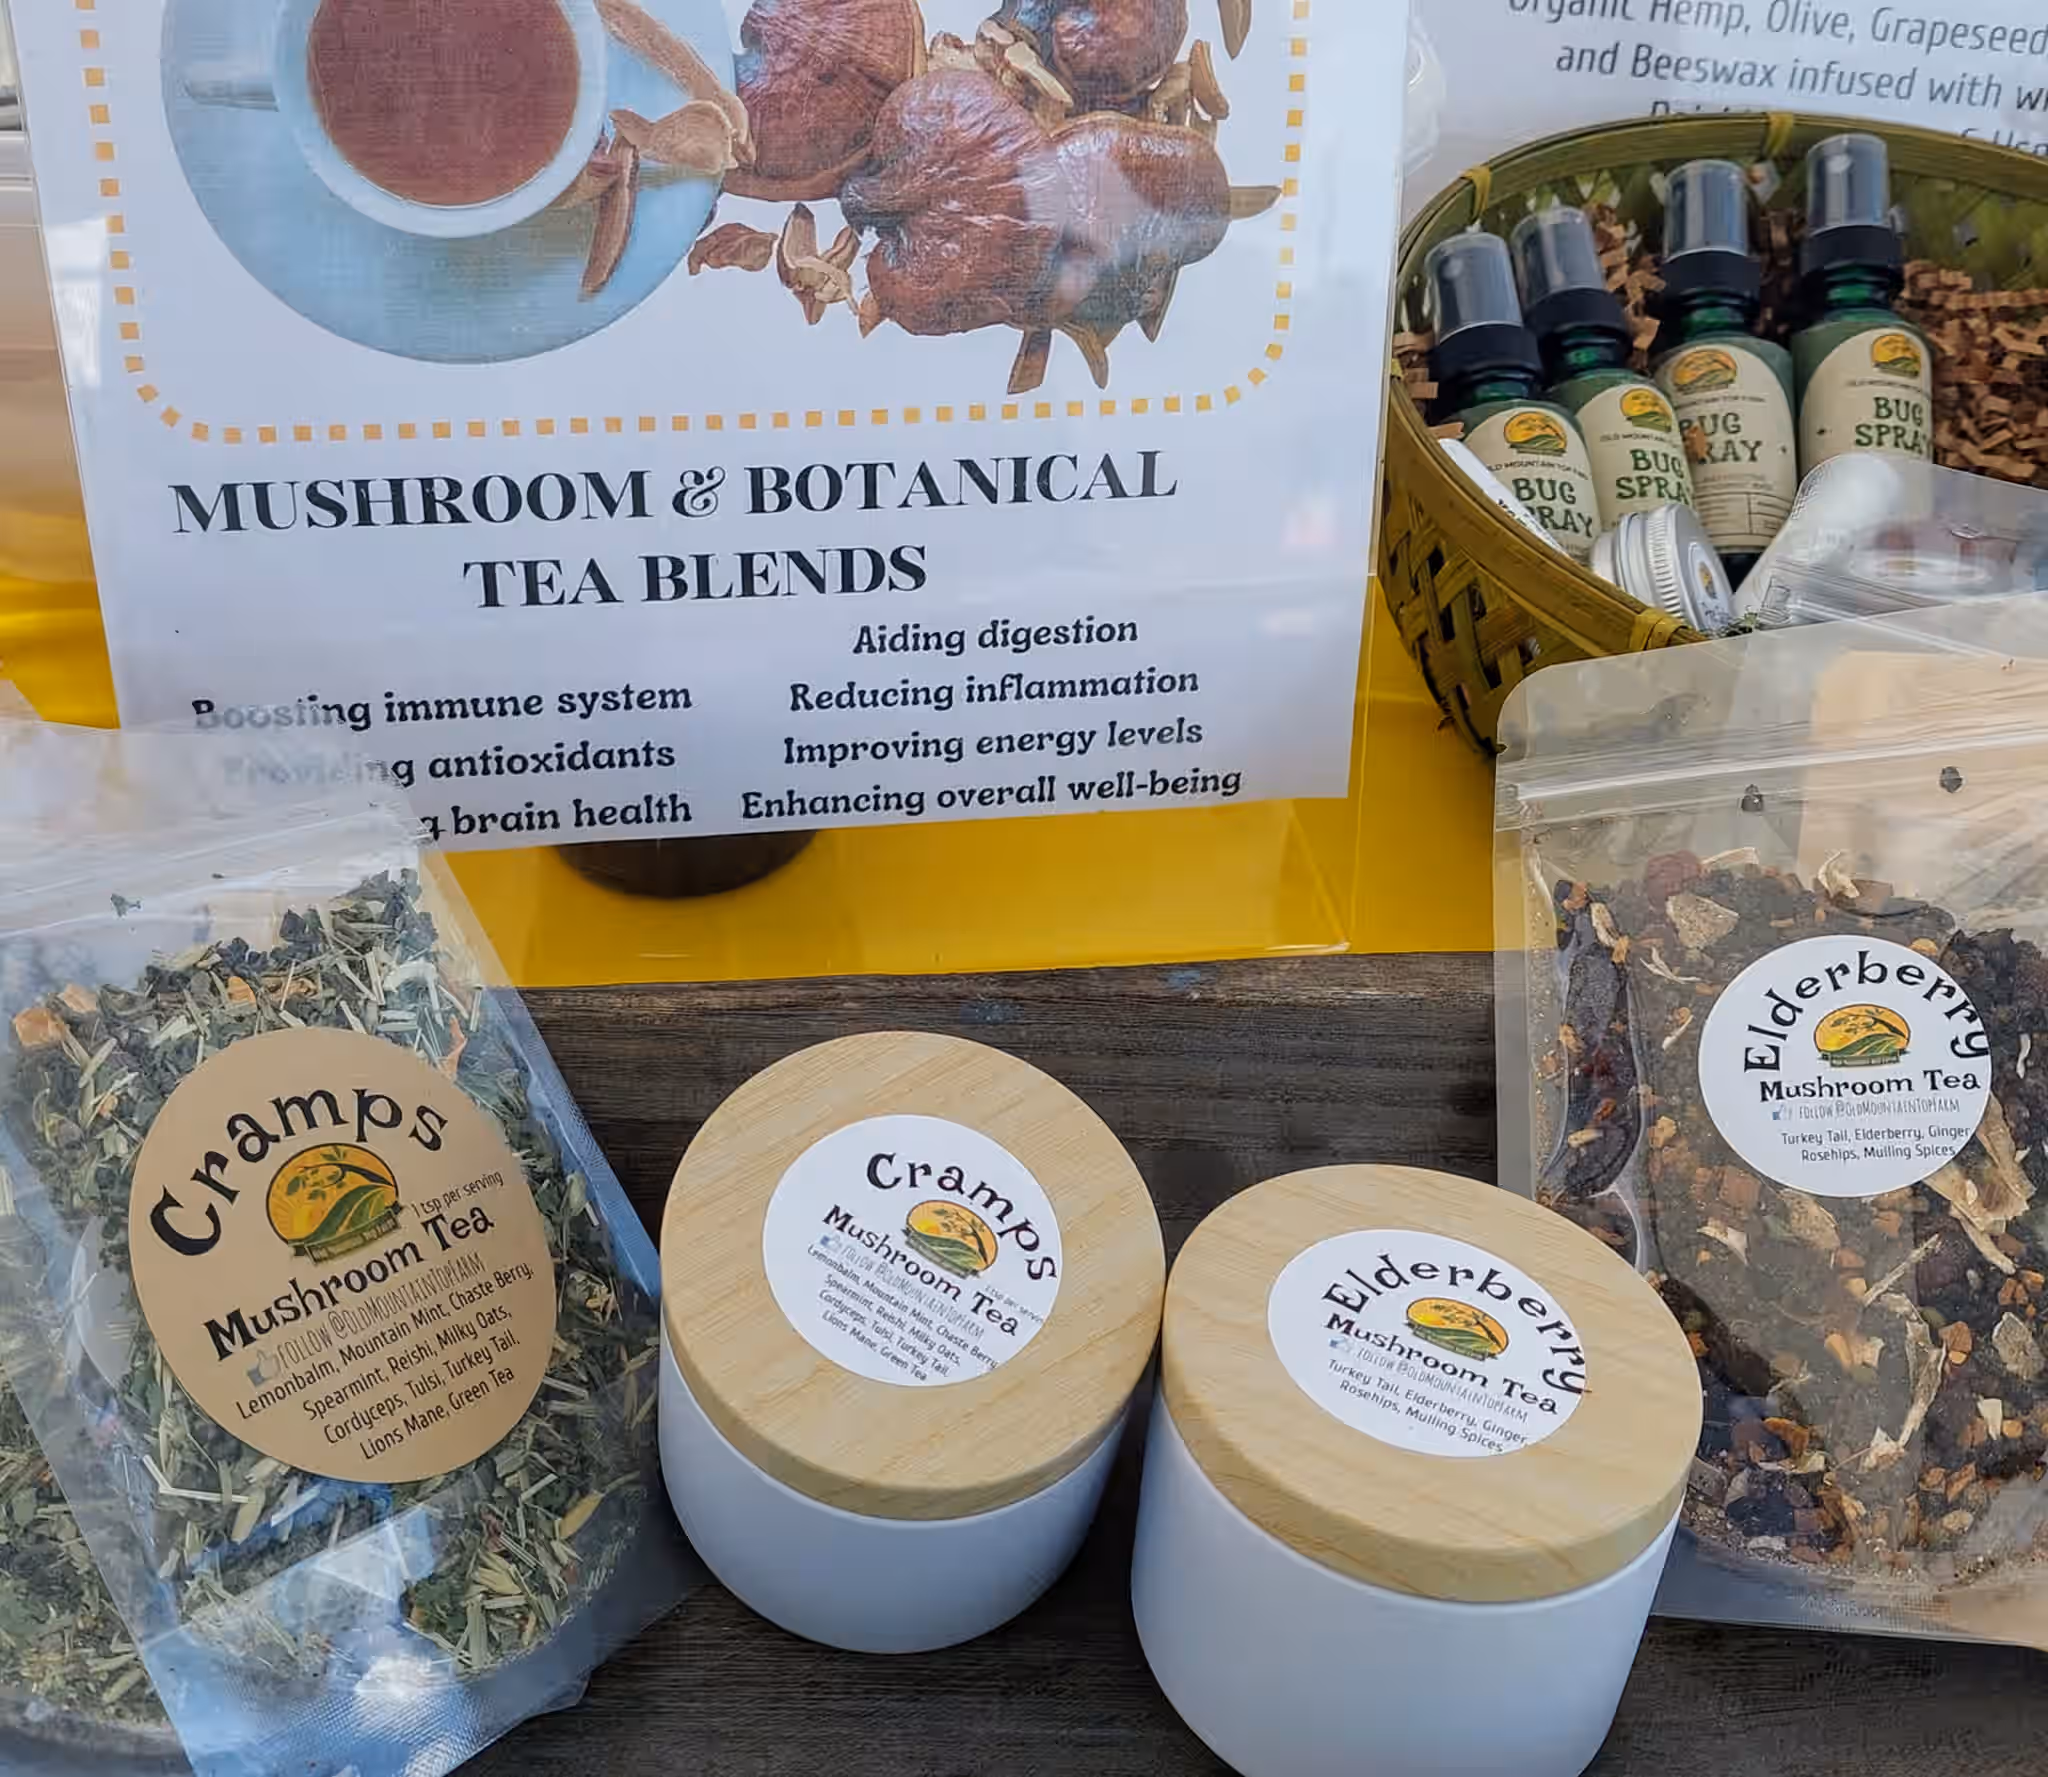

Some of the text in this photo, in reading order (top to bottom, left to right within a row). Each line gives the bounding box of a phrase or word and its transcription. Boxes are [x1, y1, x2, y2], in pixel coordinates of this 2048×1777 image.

[1649, 0, 1751, 36] Hemp,
[1767, 0, 1855, 43] Olive,
[1556, 41, 1621, 76] and
[1630, 43, 1778, 88] Beeswax
[1788, 58, 1918, 101] infused
[1928, 72, 2002, 108] with
[1855, 423, 1928, 456] SPRA
[1872, 396, 1923, 427] BUG
[1629, 448, 1685, 480] BUG
[1697, 440, 1763, 465] RAY
[167, 450, 1179, 534] MUSHROOM & BOTANICAL
[1511, 477, 1577, 505] BUG
[1523, 504, 1594, 538] RAY
[1615, 475, 1690, 505] SPRA
[463, 544, 927, 609] TEA BLENDS
[853, 616, 1139, 657] Aiding digestion
[191, 683, 693, 732] Boosting immune system
[790, 667, 1200, 712] Reducing inflammation
[428, 741, 676, 779] antioxidants
[783, 717, 1203, 768] Improving energy levels
[451, 801, 561, 836] brain
[573, 794, 693, 829] health
[741, 767, 1243, 820] Enhancing overall well-being
[1744, 950, 1990, 1074] Elderberry
[1760, 1069, 1982, 1103] Mushroom Tea
[1781, 1125, 1970, 1146] Turkey Tail, Elderberry, Ginger
[1802, 1144, 1956, 1162] Rosehips, Mulling Spices
[149, 1088, 449, 1257] Cramps
[421, 1197, 442, 1217] tsp
[442, 1189, 463, 1209] per
[463, 1170, 505, 1197] serving
[866, 1152, 1058, 1282] Cramps
[202, 1241, 425, 1362] Mushroom
[422, 1204, 496, 1252] Tea
[807, 1244, 861, 1286] Lemonbalm,
[862, 1280, 910, 1314] Mountain
[936, 1324, 970, 1351] Chaste
[822, 1204, 962, 1301] Mushroom
[970, 1290, 1018, 1337] Tea
[236, 1262, 534, 1420] Lemonbalm, Mountain Mint, Chaste Berry,
[818, 1289, 868, 1327] Cordyceps,
[896, 1337, 929, 1366] Turkey
[822, 1309, 928, 1382] Lions Mane, Green Tea
[824, 1273, 874, 1312] Spearmint,
[909, 1326, 937, 1351] Milky
[937, 1343, 961, 1367] Oats,
[1321, 1253, 1592, 1396] Elderberry
[303, 1303, 512, 1421] Spearmint, Reishi, Milky Oats,
[323, 1329, 520, 1446] Cordyceps, Tulsi, Turkey Tail,
[1322, 1312, 1489, 1388] Mushroom
[1502, 1377, 1559, 1416] Tea
[359, 1366, 515, 1461] Lions Mane, Green Tea
[1328, 1358, 1529, 1446] Turkey Tail, Elderberry, Ginger
[1340, 1379, 1504, 1453] Rosehips, Mulling Spices
